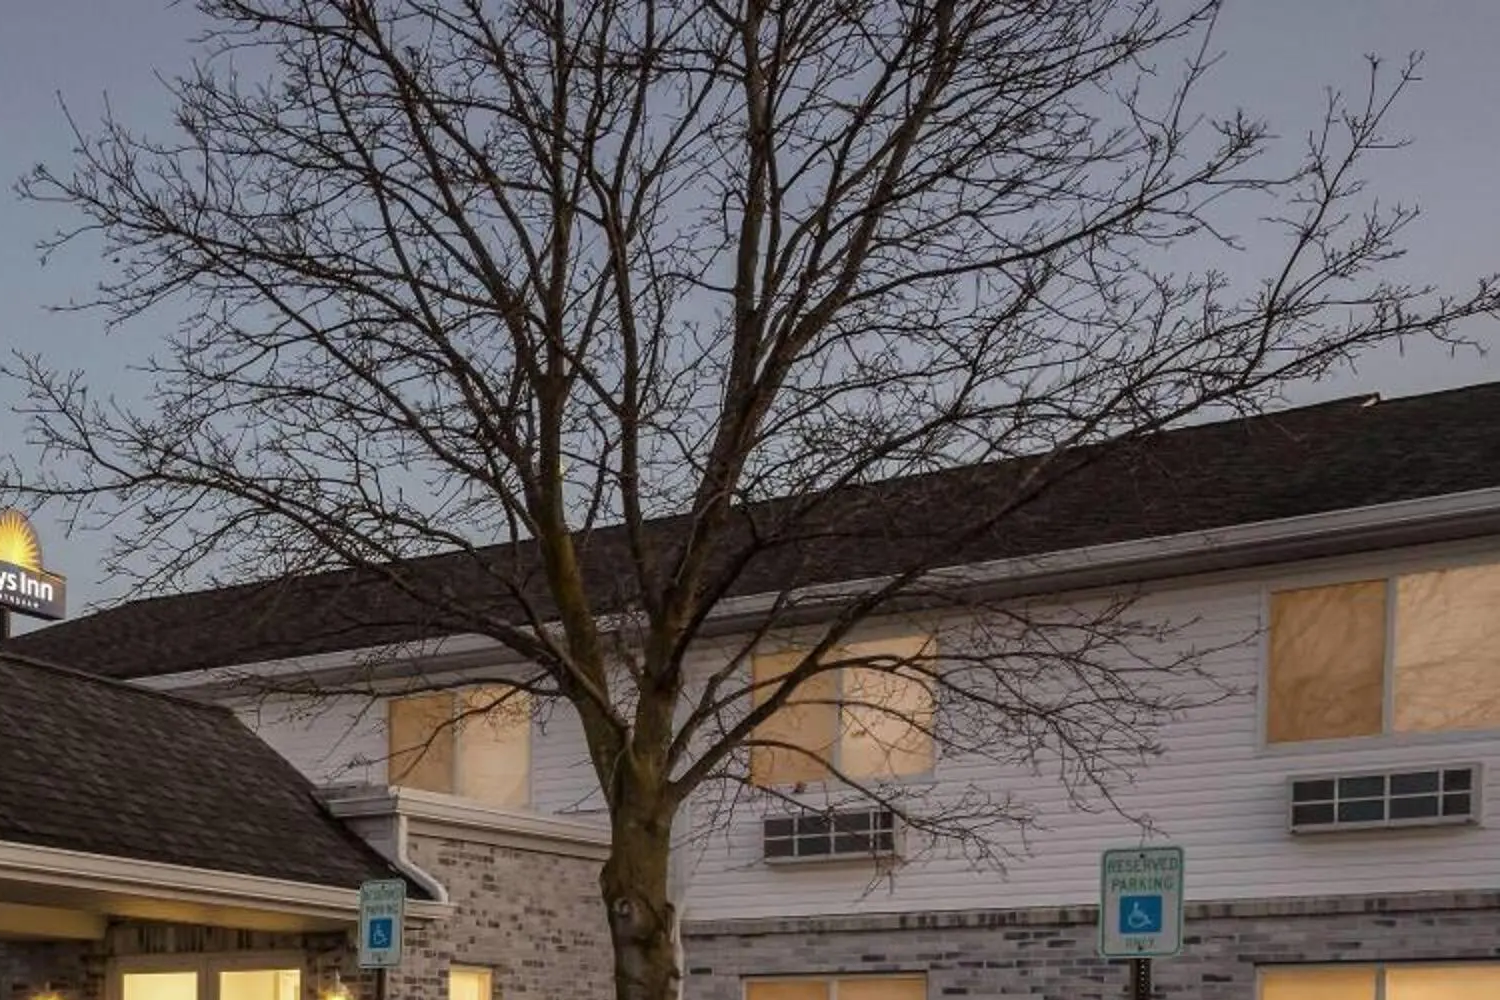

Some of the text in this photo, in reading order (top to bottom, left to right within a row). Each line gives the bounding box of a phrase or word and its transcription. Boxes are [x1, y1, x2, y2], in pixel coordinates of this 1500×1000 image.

[20, 572, 53, 602] Inn
[1108, 857, 1179, 873] RESERVED
[1111, 876, 1174, 892] PARKING
